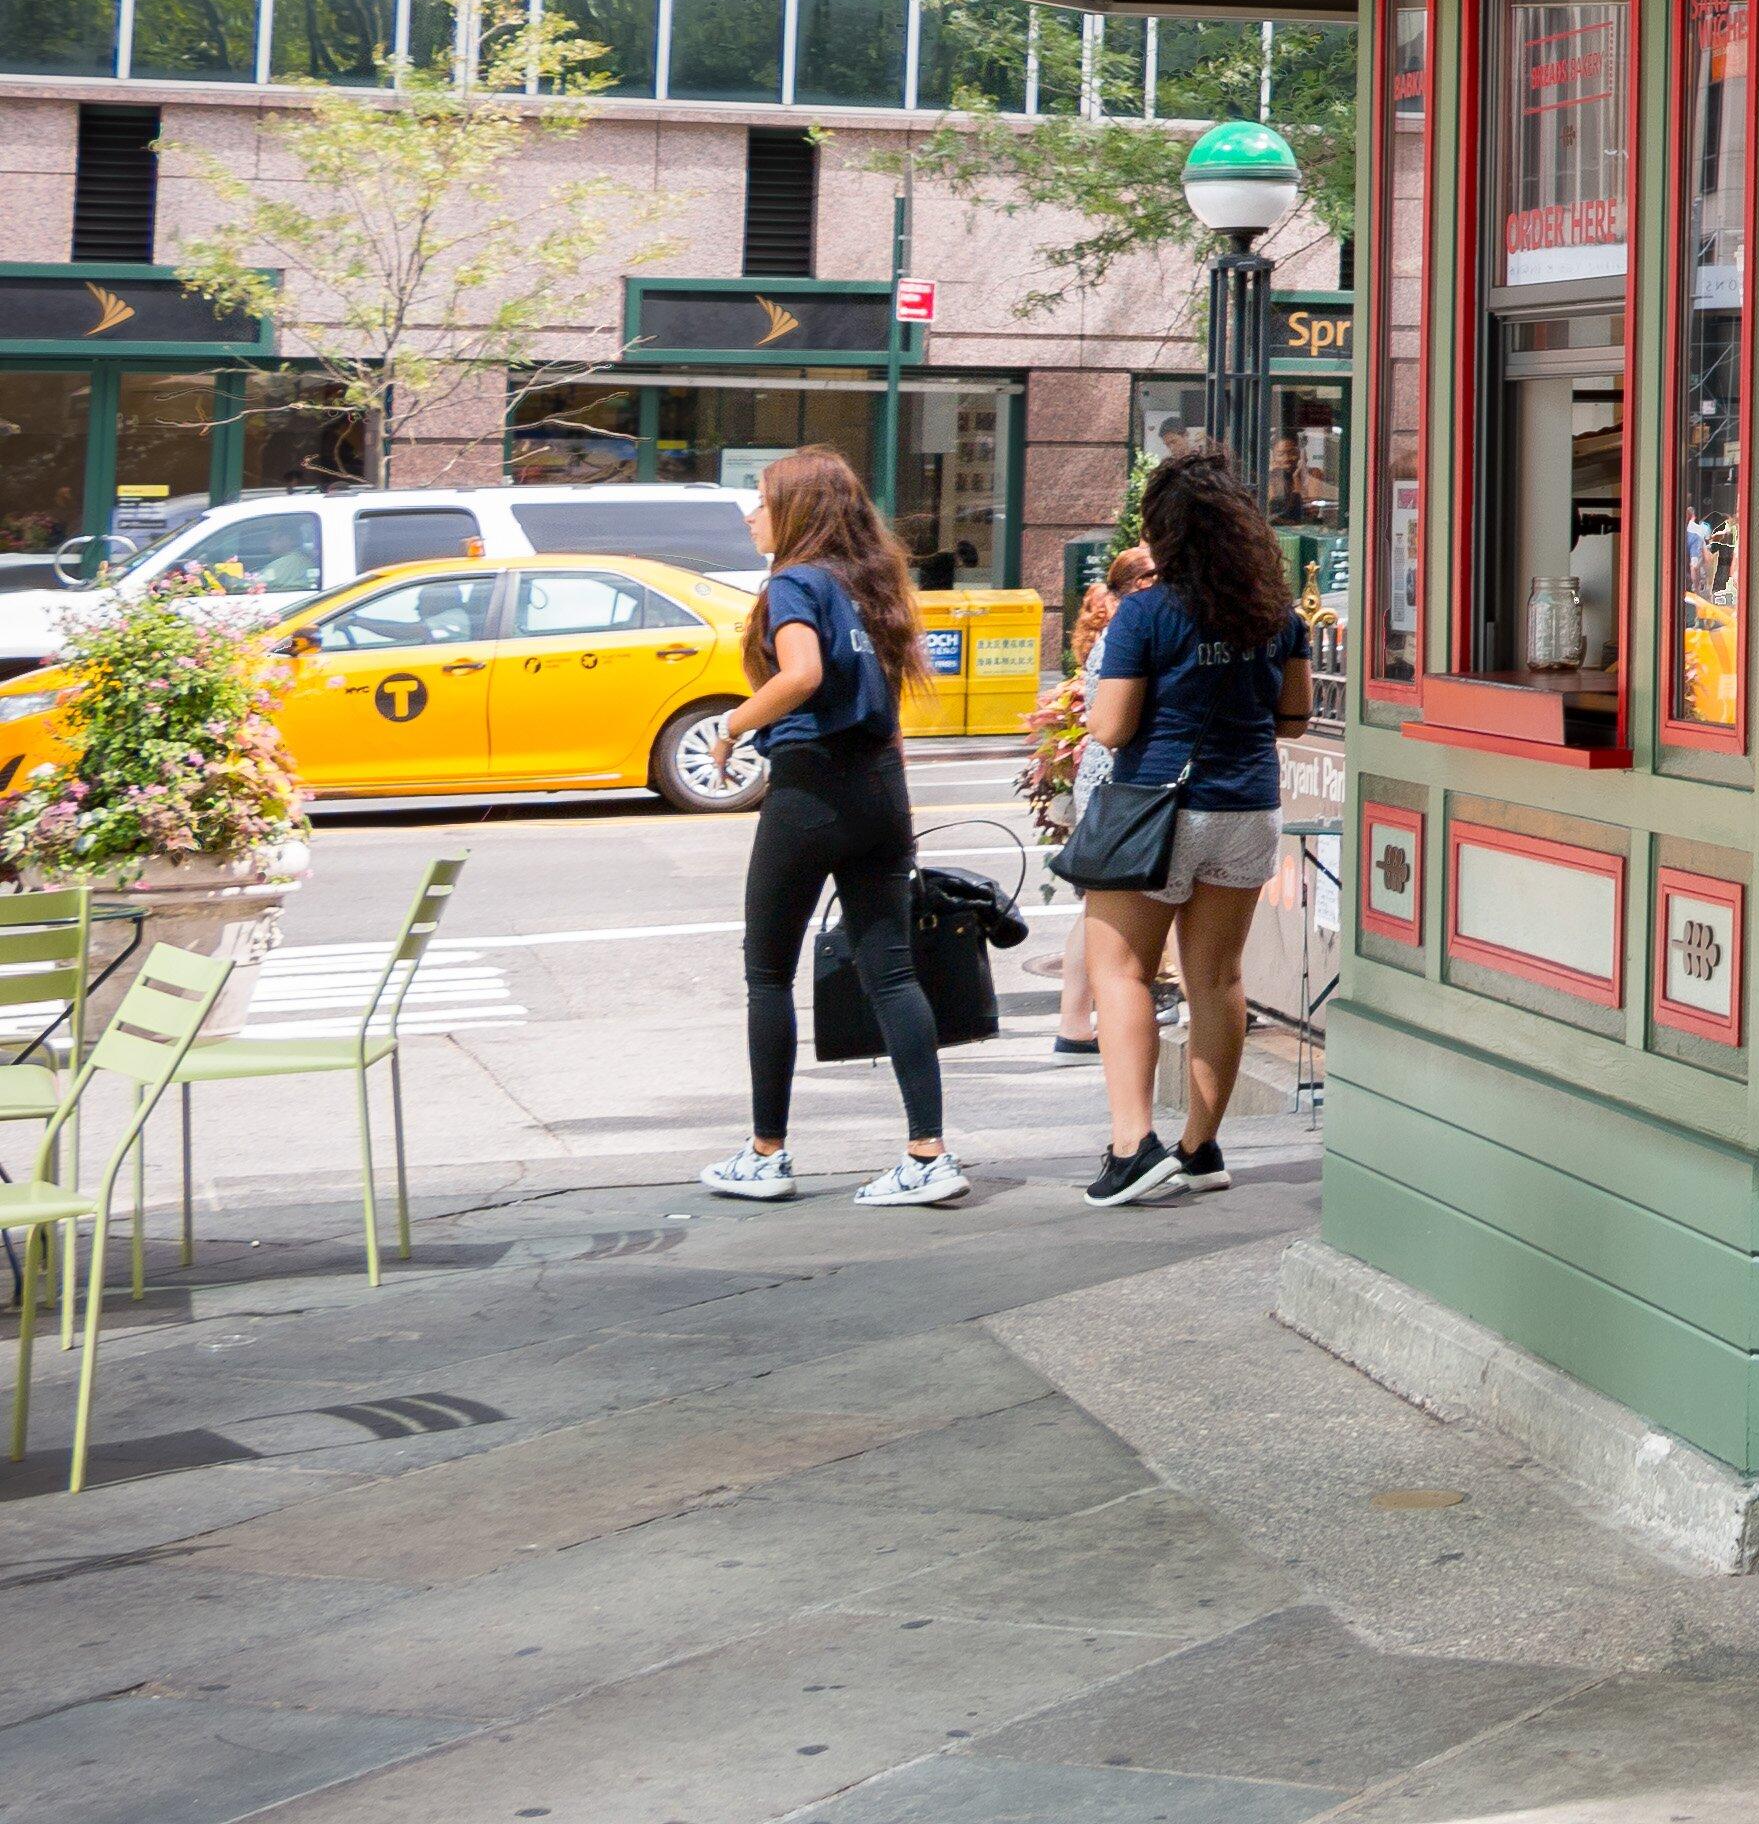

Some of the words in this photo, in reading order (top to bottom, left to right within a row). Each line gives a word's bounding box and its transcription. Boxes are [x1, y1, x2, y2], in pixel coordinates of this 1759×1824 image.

[1531, 58, 1566, 90] BREADS
[1566, 52, 1602, 81] BAKERY
[1506, 203, 1565, 254] ORDER
[1571, 196, 1617, 245] HERE
[1288, 310, 1352, 356] Spr
